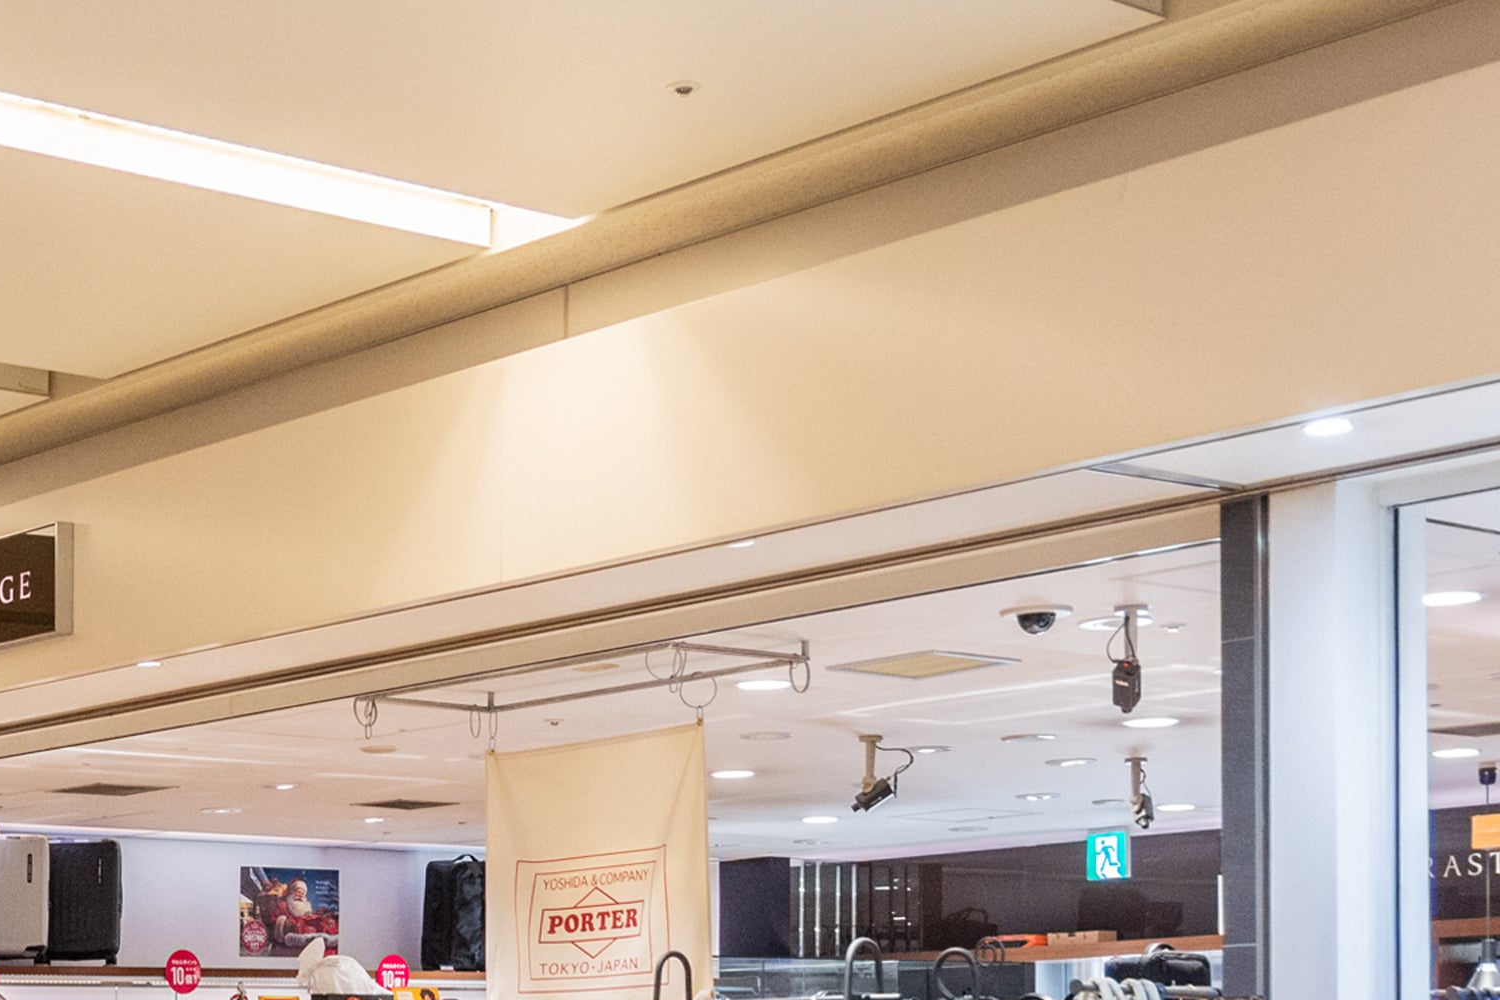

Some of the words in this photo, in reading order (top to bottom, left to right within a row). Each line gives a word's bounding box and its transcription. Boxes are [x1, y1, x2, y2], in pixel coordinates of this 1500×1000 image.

[543, 875, 588, 891] YOSHIDA
[591, 875, 598, 886] &
[599, 868, 650, 886] COMPANY
[546, 908, 639, 935] PORTER
[539, 962, 589, 976] TOKYO
[597, 957, 639, 973] JAPAN
